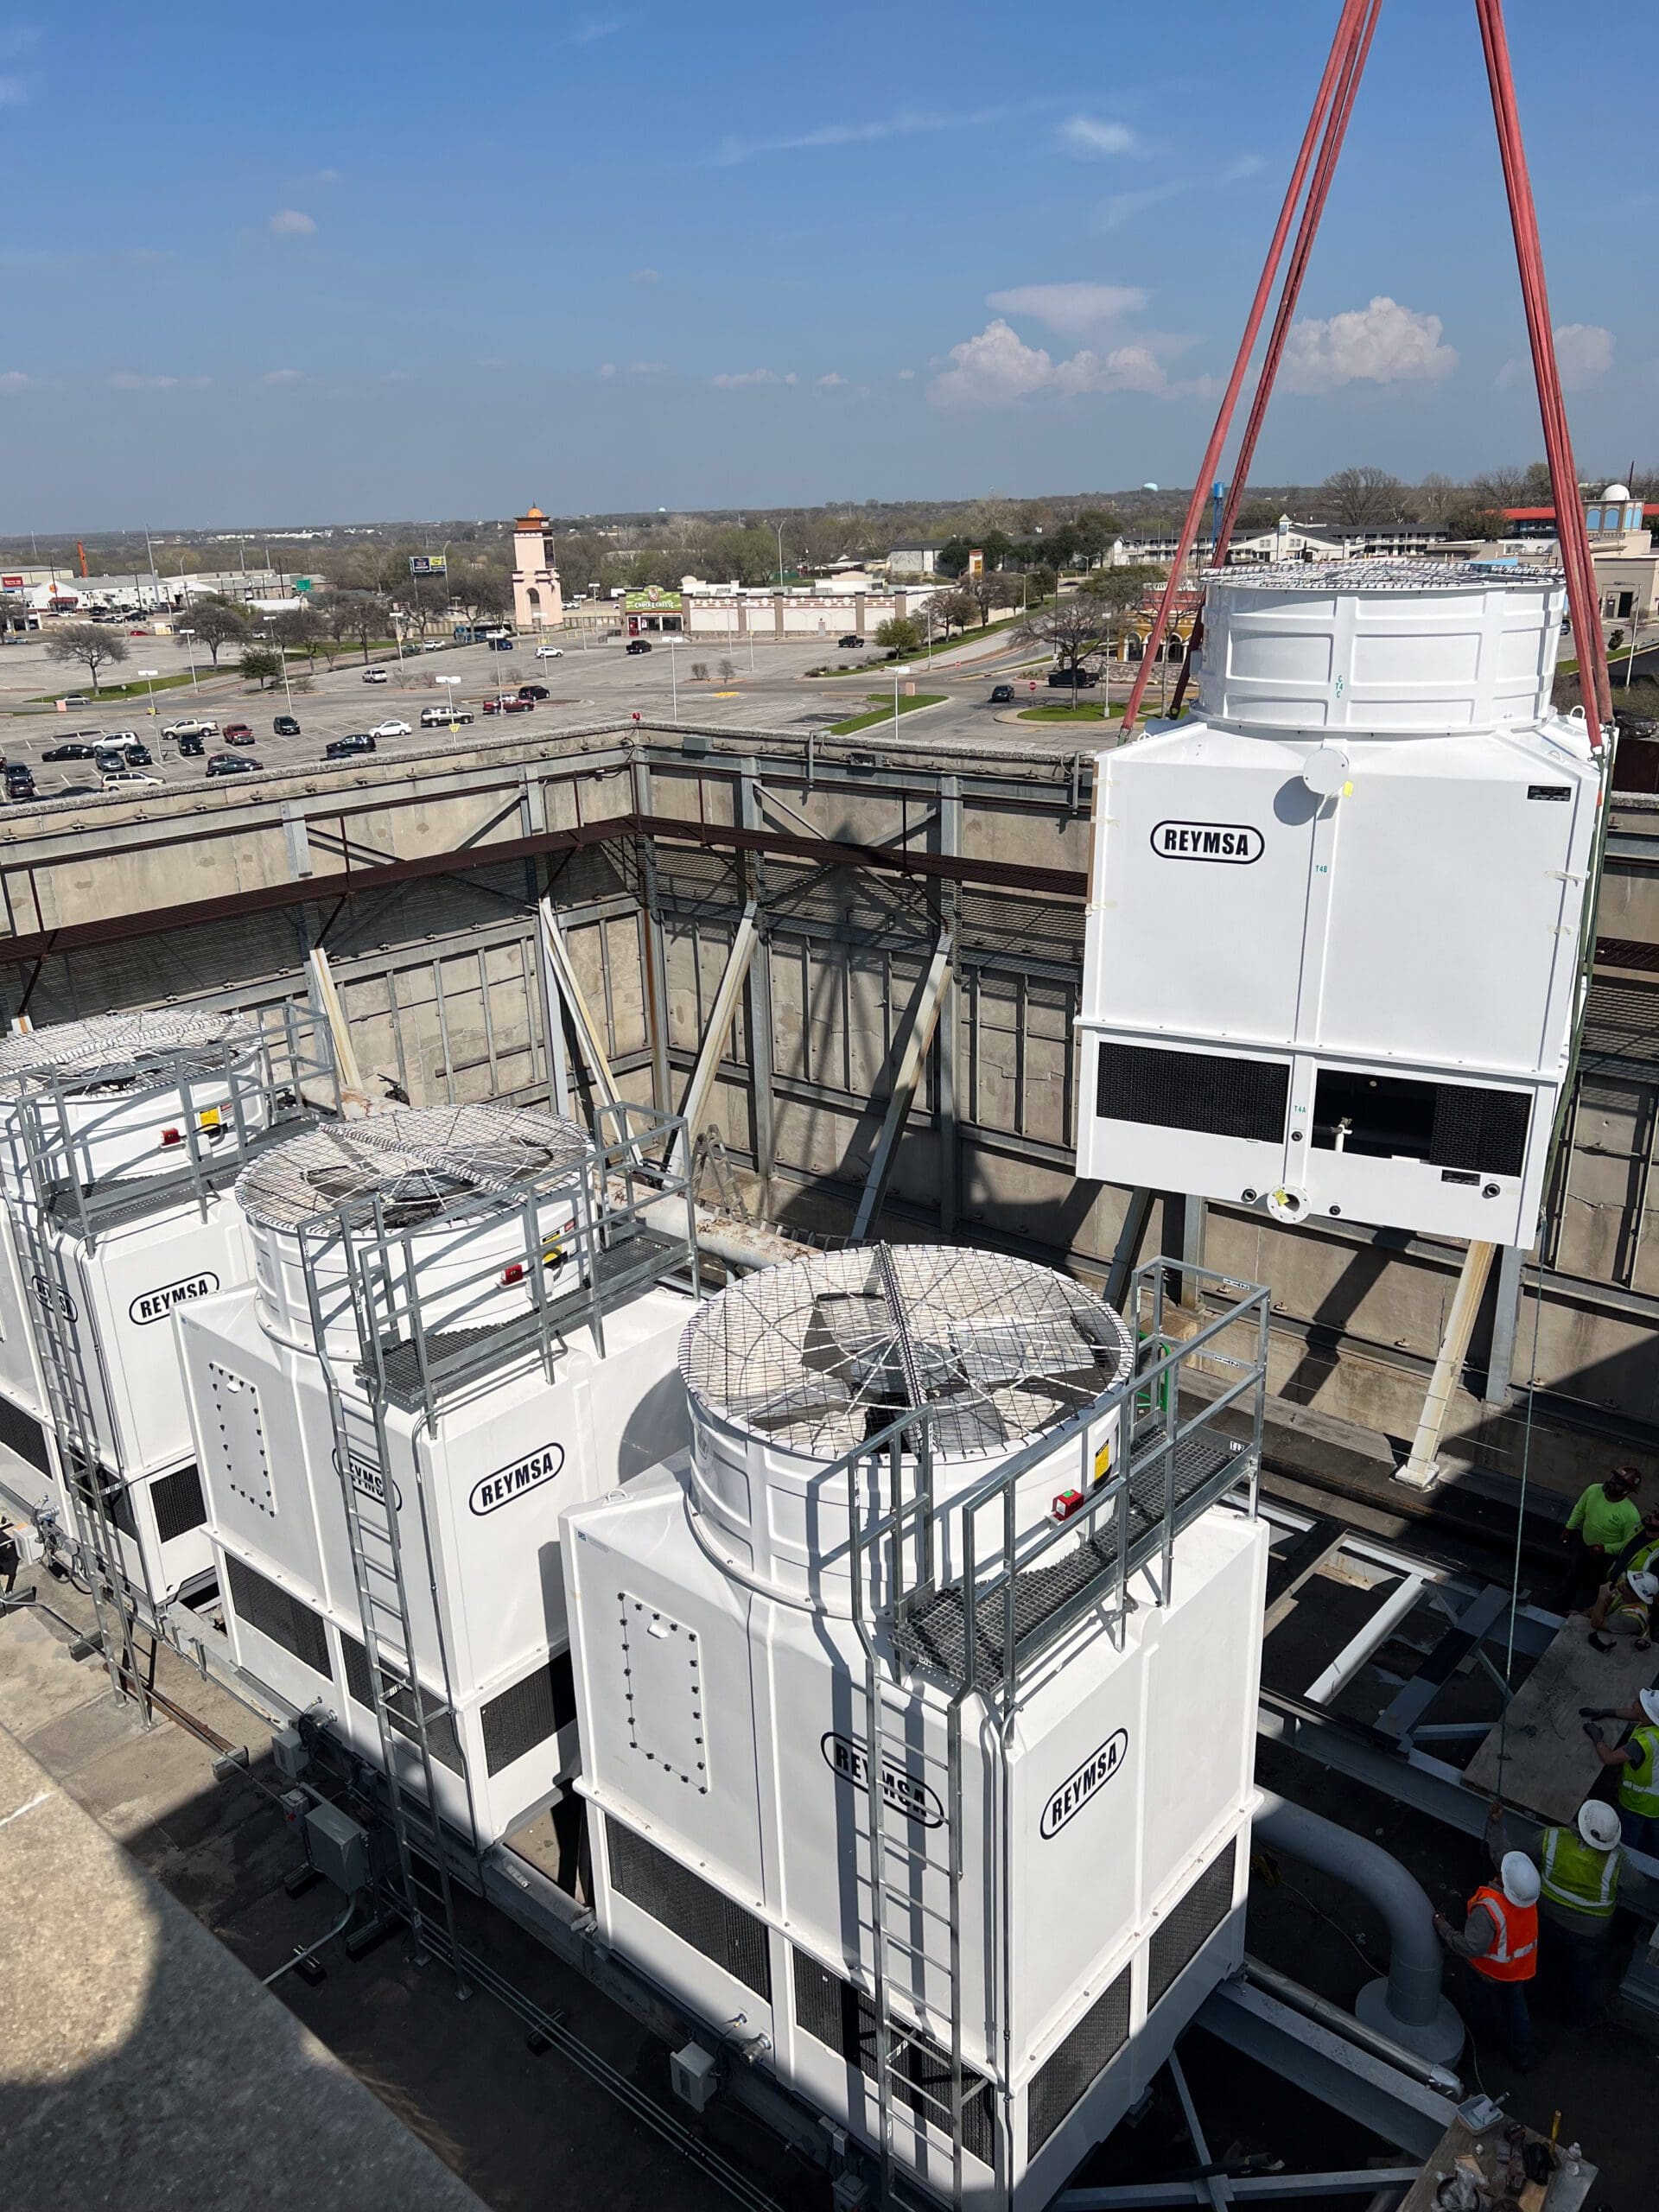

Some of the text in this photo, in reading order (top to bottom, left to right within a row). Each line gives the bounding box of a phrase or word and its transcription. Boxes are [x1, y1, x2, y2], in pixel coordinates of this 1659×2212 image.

[1164, 829, 1249, 855] REYMSA
[1315, 864, 1328, 873] T4B
[140, 1279, 209, 1319] REYMSA
[481, 1452, 553, 1508] REYMSA
[1052, 1742, 1117, 1827] REYMSA
